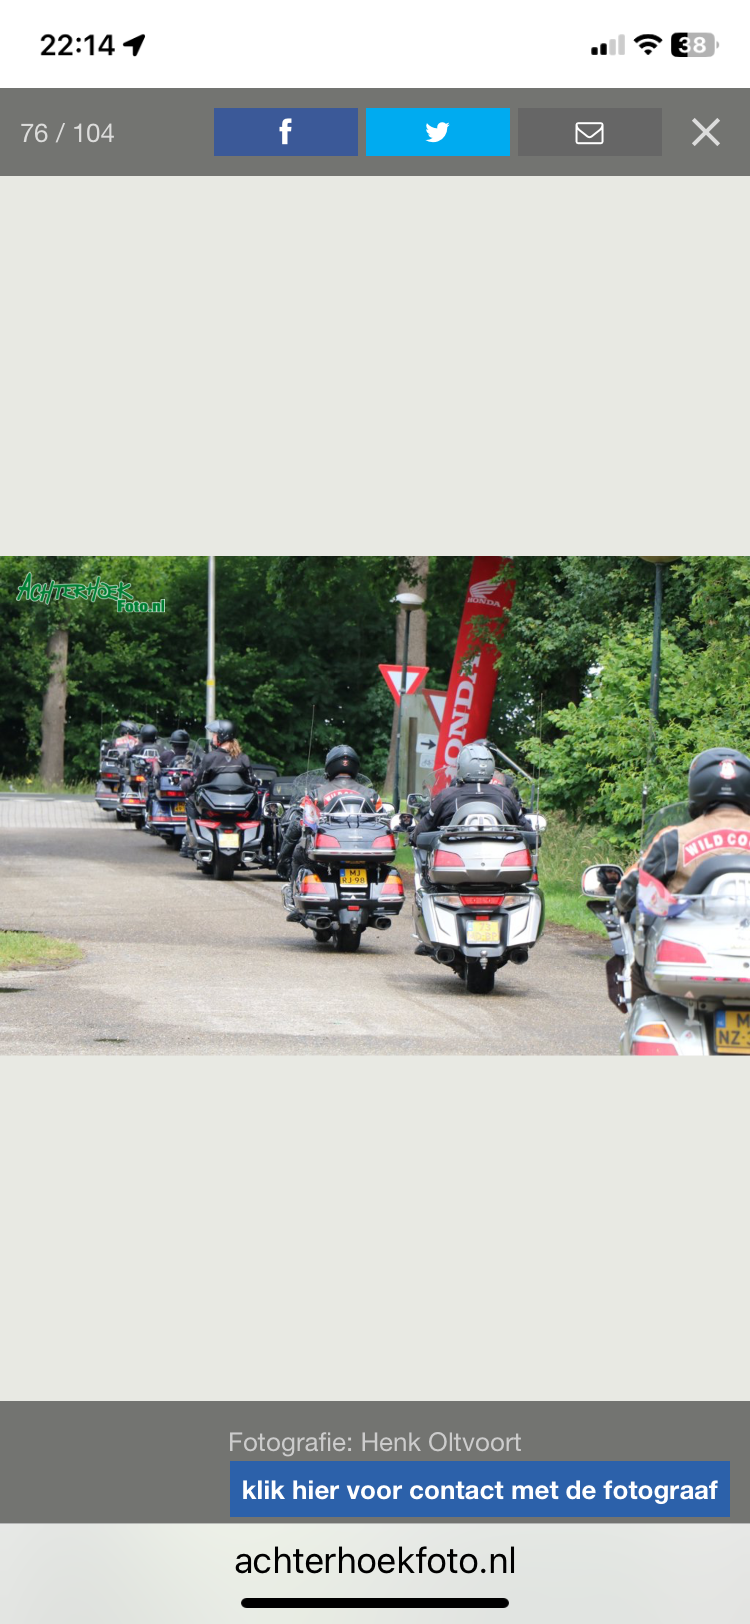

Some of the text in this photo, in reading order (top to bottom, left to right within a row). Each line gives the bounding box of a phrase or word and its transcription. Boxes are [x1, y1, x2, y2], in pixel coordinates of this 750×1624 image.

[467, 597, 501, 608] HONDA
[685, 833, 750, 857] WILD CO
